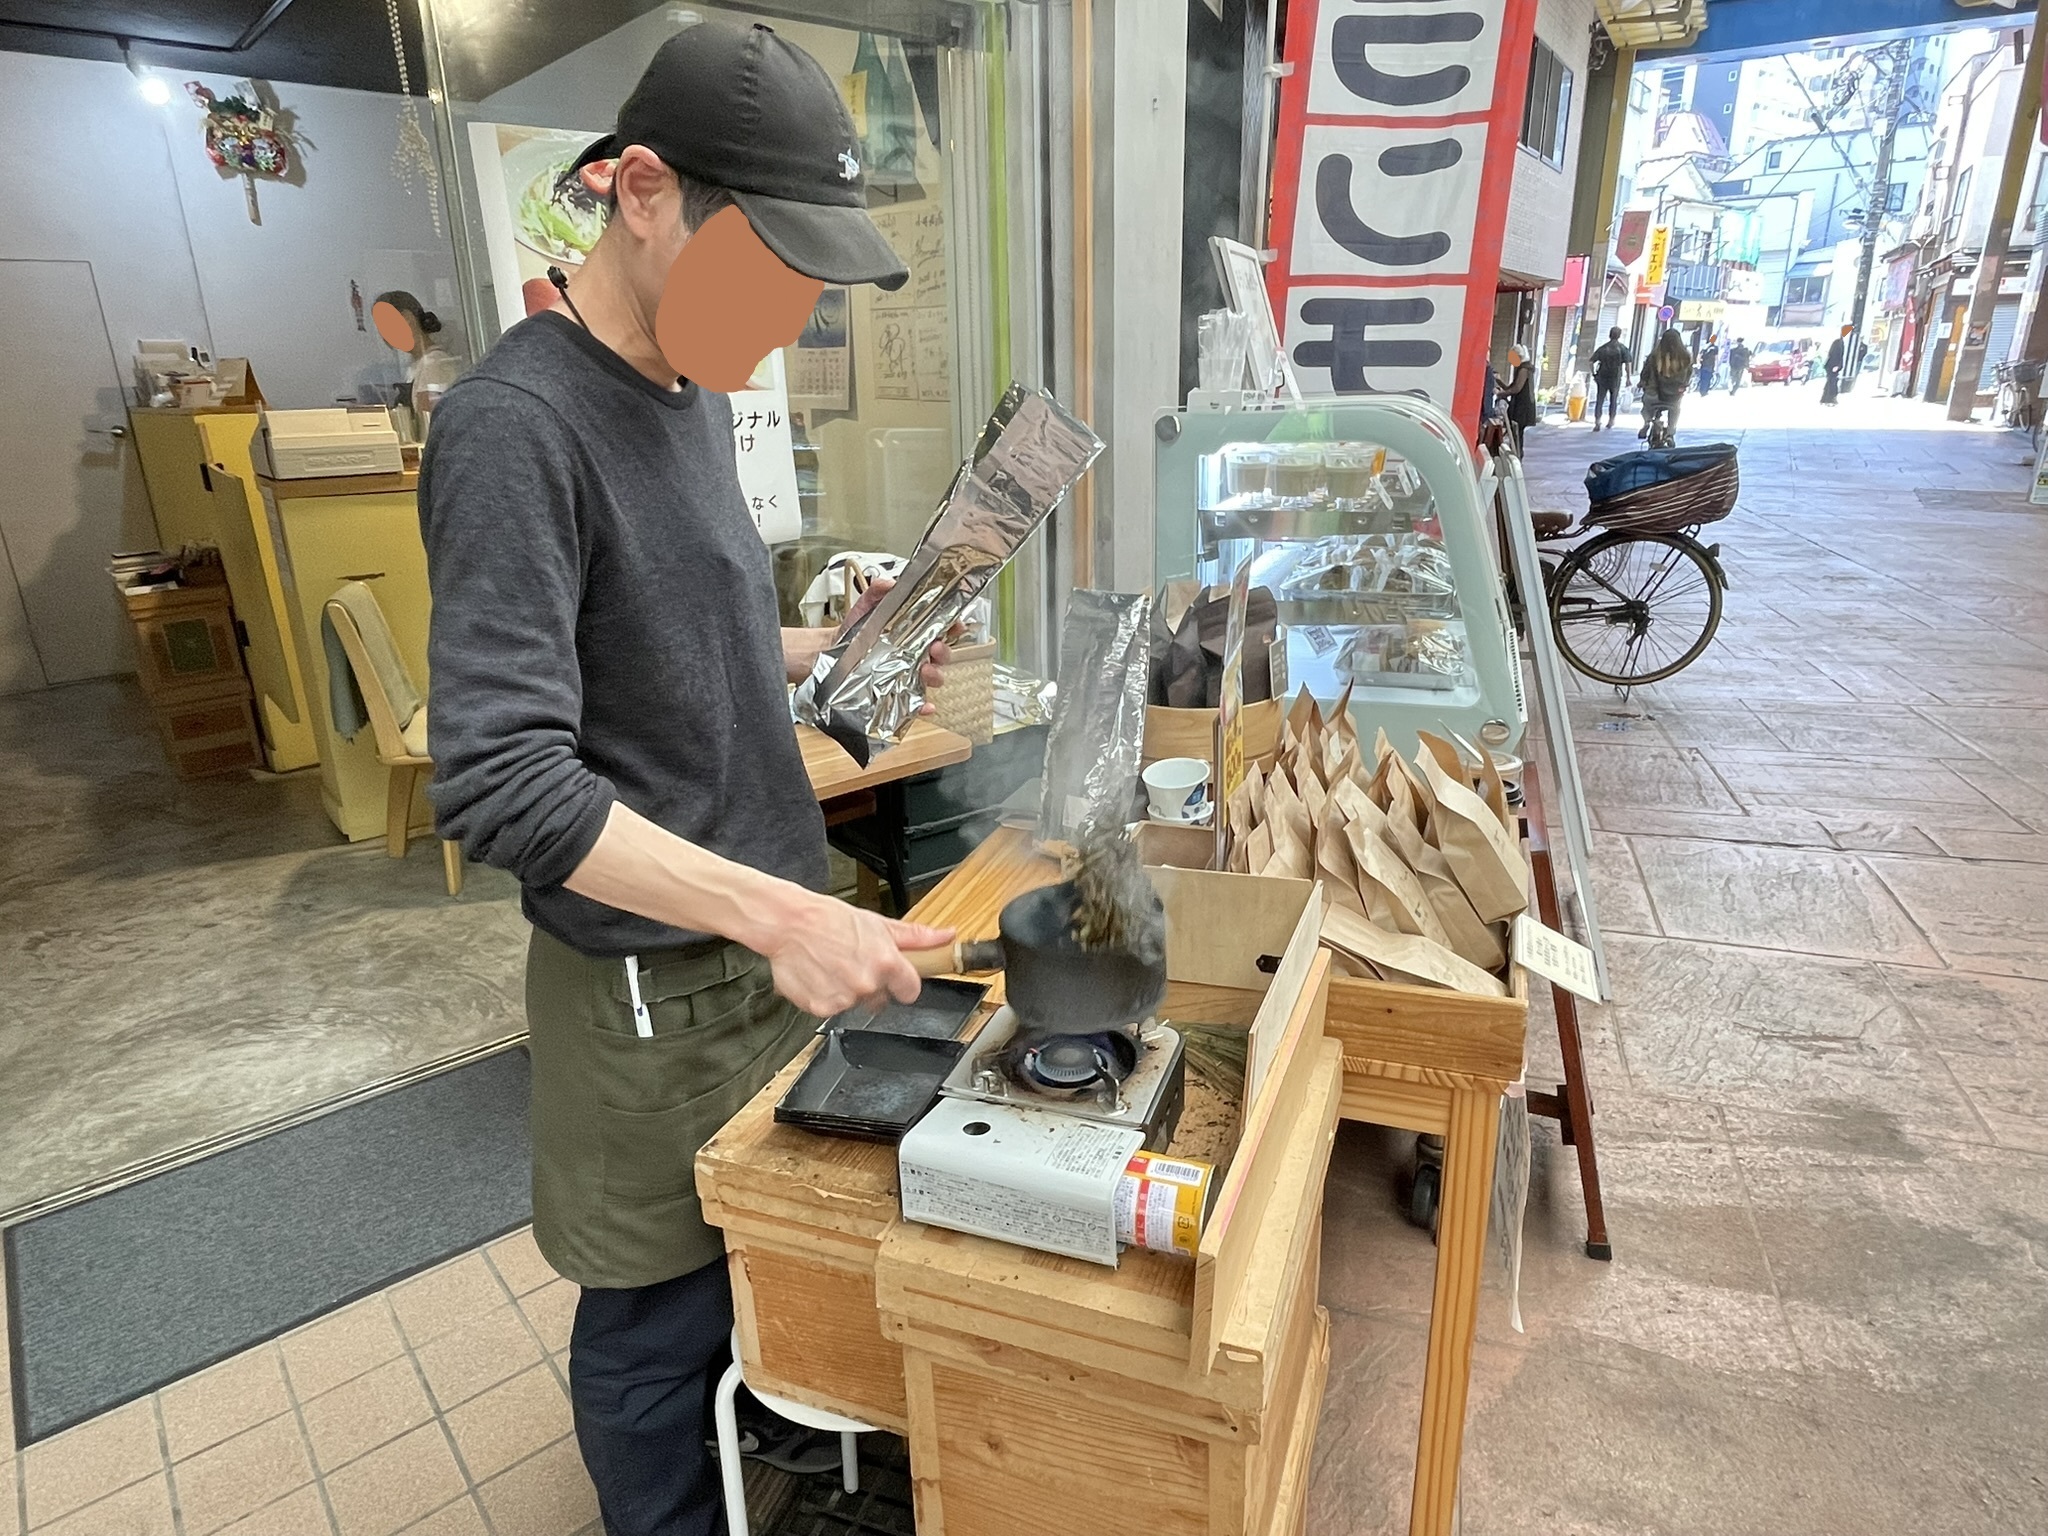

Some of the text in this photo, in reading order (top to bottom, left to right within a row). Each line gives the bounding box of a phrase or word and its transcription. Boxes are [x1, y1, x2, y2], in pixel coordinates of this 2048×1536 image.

[740, 434, 755, 452] け
[307, 453, 372, 467] SHARP
[752, 495, 778, 510] なく
